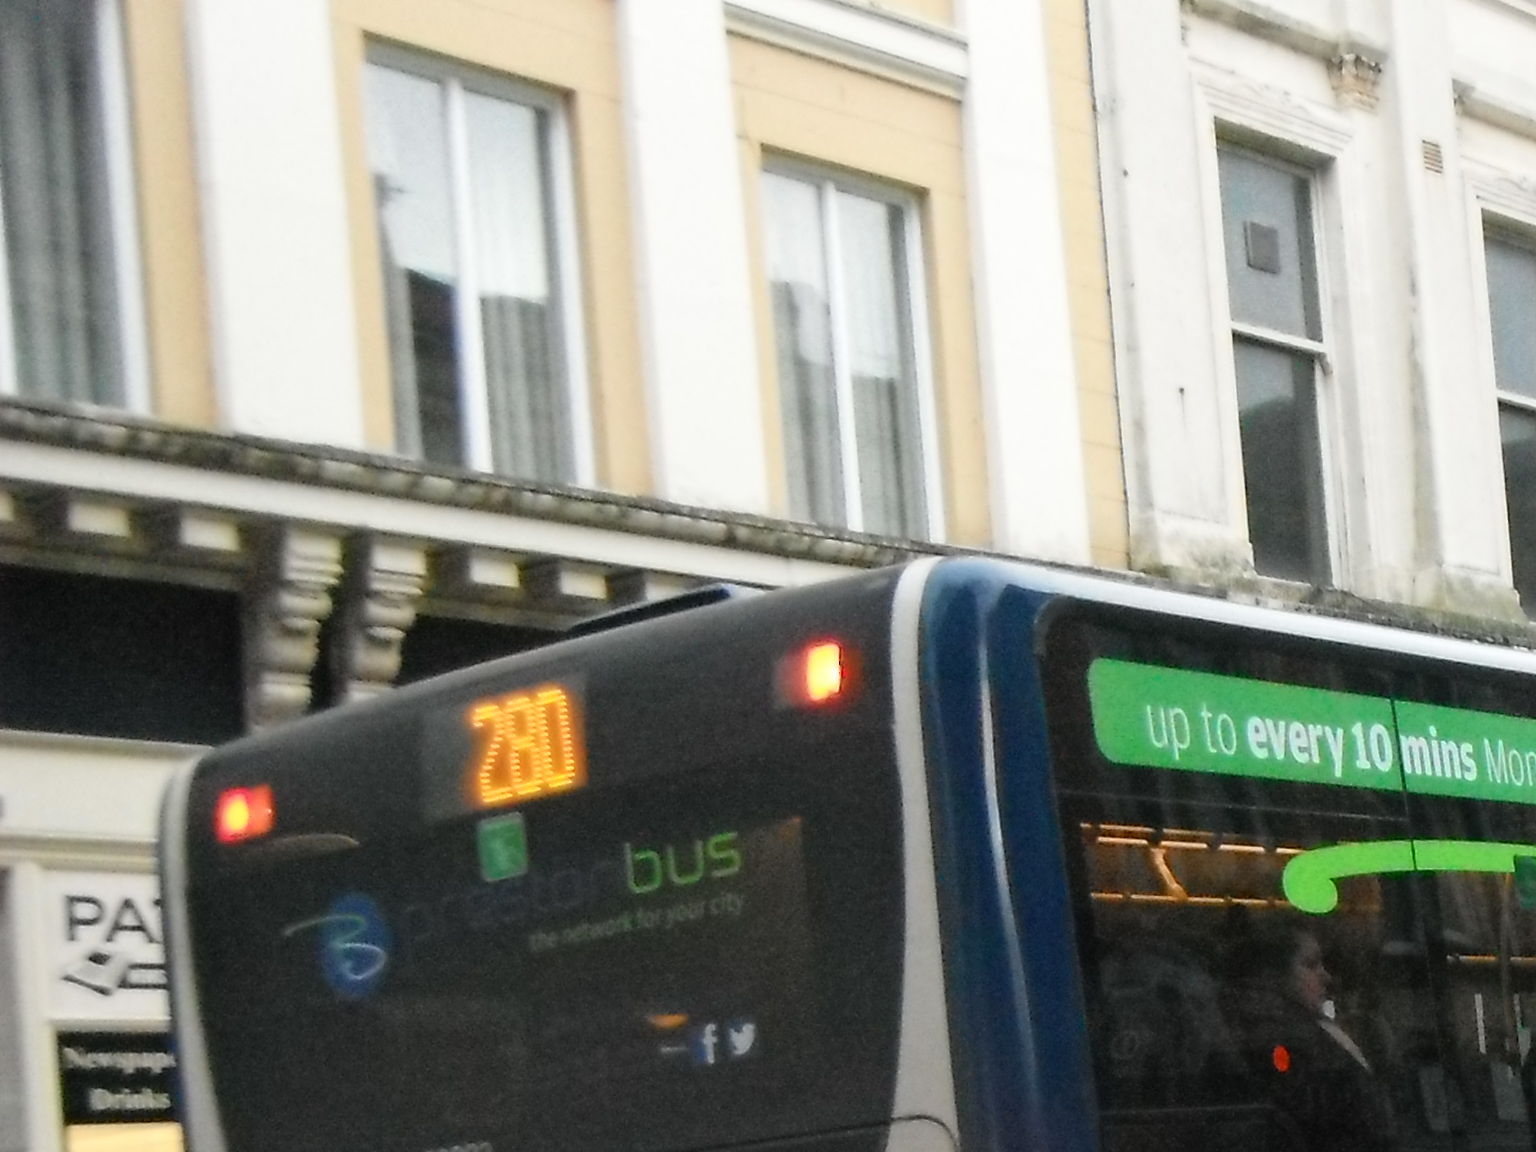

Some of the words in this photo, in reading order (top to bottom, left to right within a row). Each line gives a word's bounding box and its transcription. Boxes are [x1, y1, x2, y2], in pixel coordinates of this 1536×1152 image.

[470, 689, 576, 803] 280
[1146, 704, 1191, 761] up
[1201, 703, 1238, 756] to
[1247, 716, 1344, 778] every
[1352, 722, 1393, 772] 10
[1400, 725, 1477, 781] mins
[65, 894, 162, 942] PA
